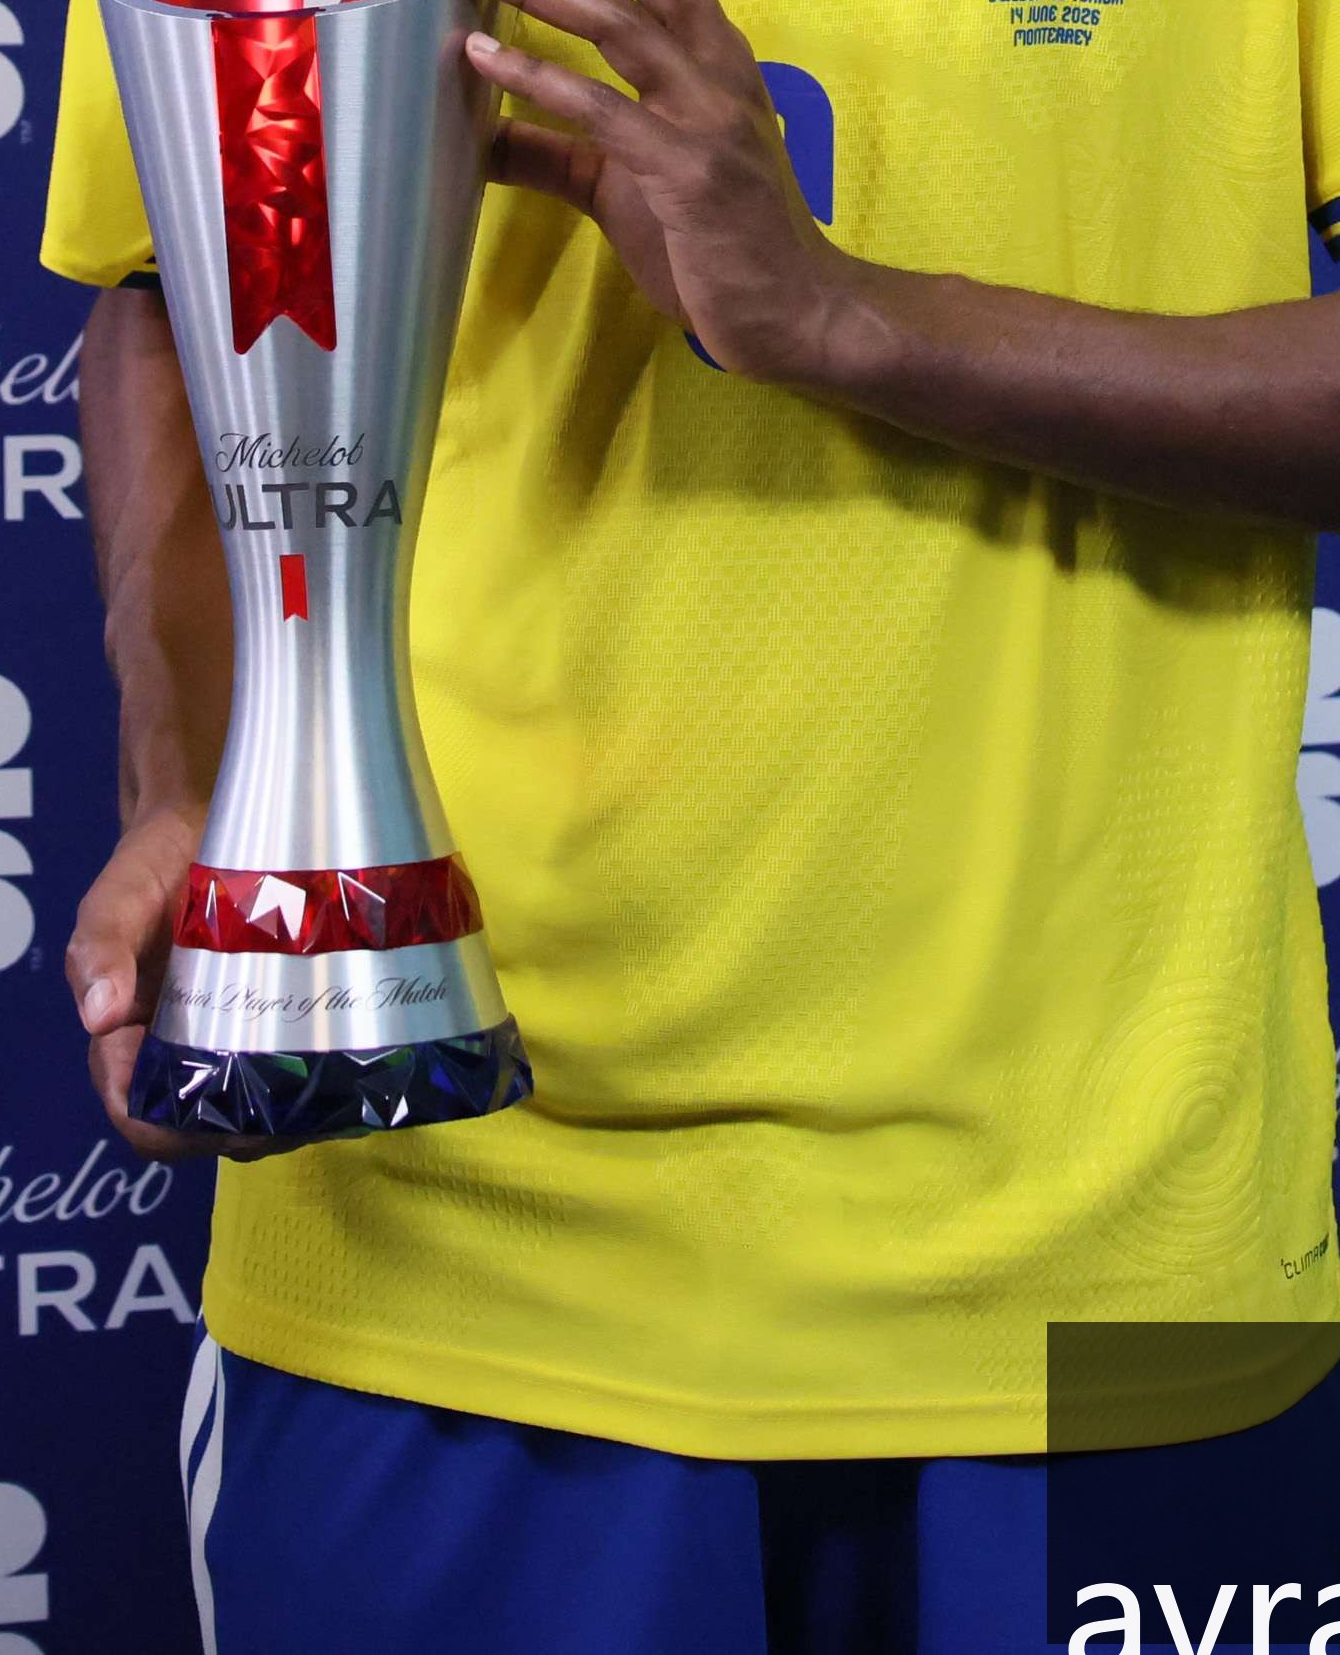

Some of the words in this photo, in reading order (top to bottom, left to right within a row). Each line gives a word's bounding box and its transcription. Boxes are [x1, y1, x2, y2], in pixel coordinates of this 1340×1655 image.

[1011, 7, 1024, 24] 14
[1027, 6, 1058, 23] JUNE
[1061, 7, 1100, 25] 2026
[1014, 27, 1093, 46] MONTERREY
[215, 432, 365, 473] Michelob
[212, 981, 295, 1023] Player
[283, 986, 338, 1023] of
[325, 987, 364, 1011] the
[365, 975, 448, 1011] Match
